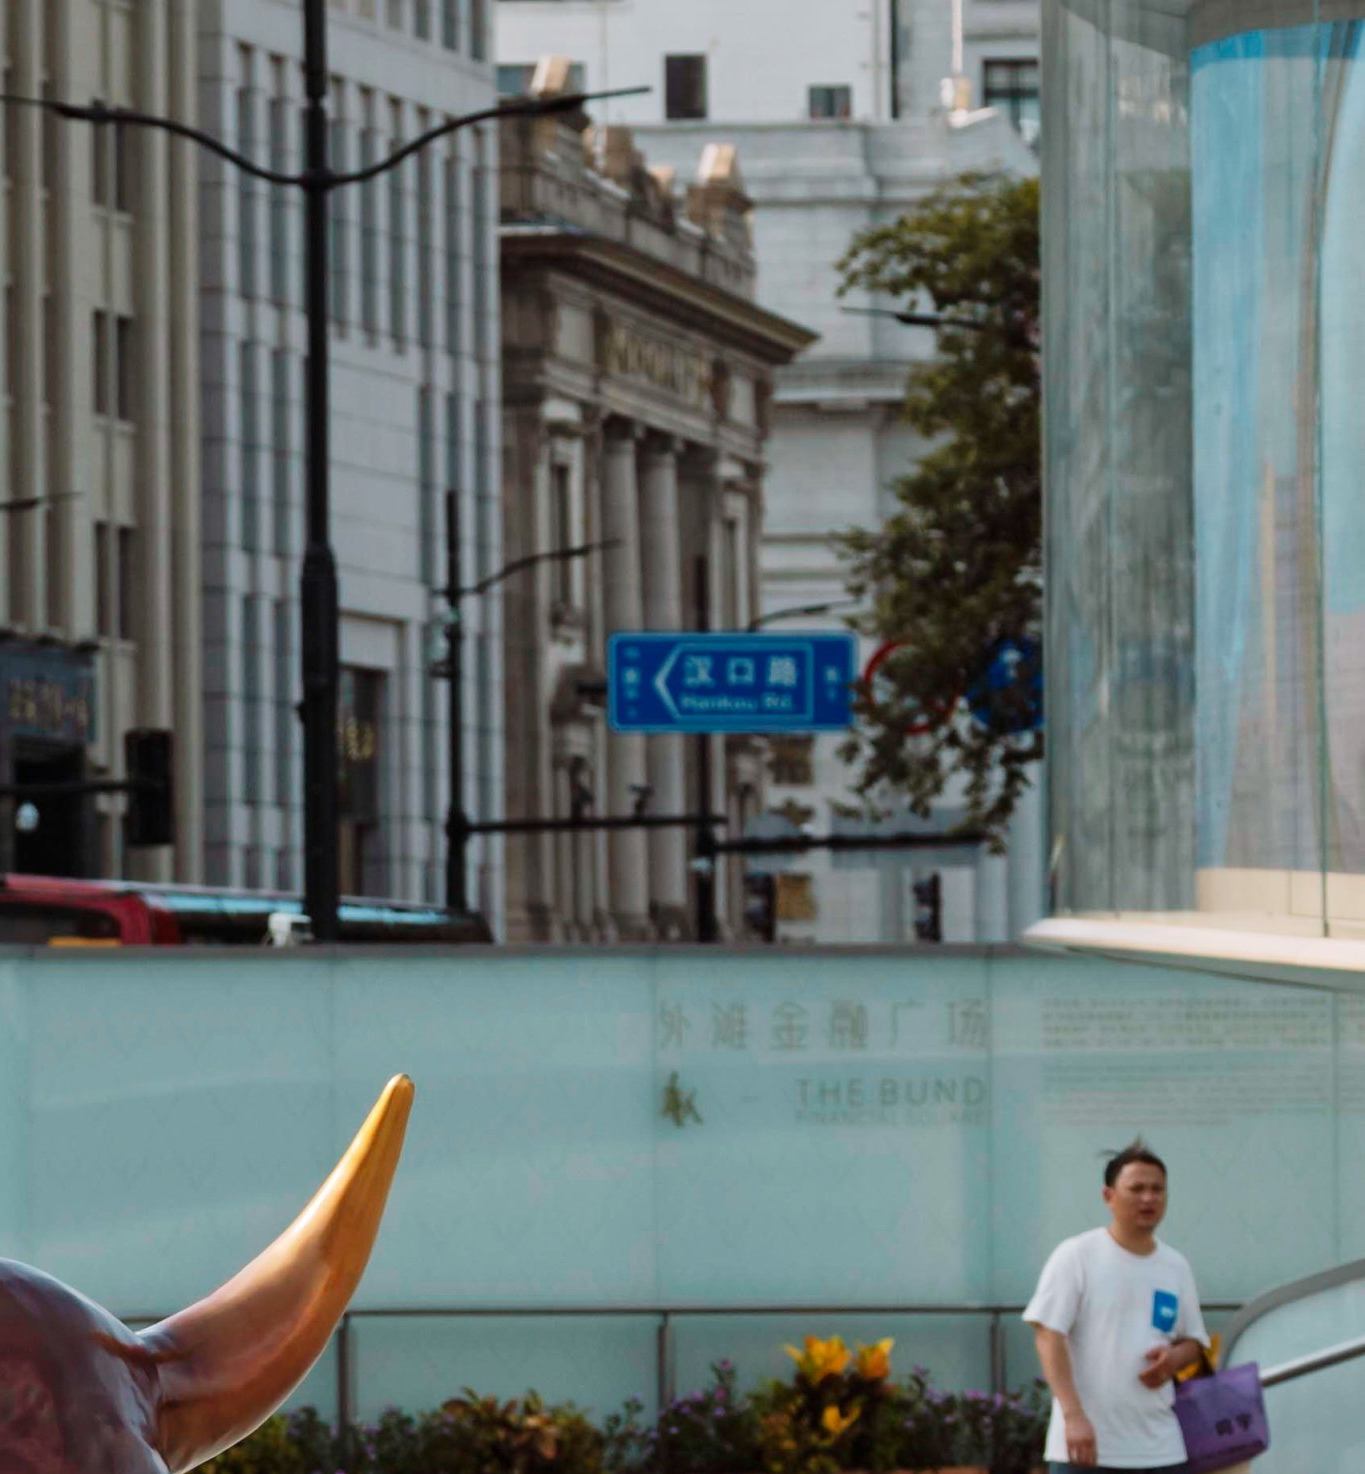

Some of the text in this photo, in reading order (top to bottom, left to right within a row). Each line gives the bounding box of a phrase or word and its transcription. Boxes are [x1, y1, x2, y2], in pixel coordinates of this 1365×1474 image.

[659, 999, 987, 1048] 外滩金融广场
[795, 1077, 987, 1106] THE BUND
